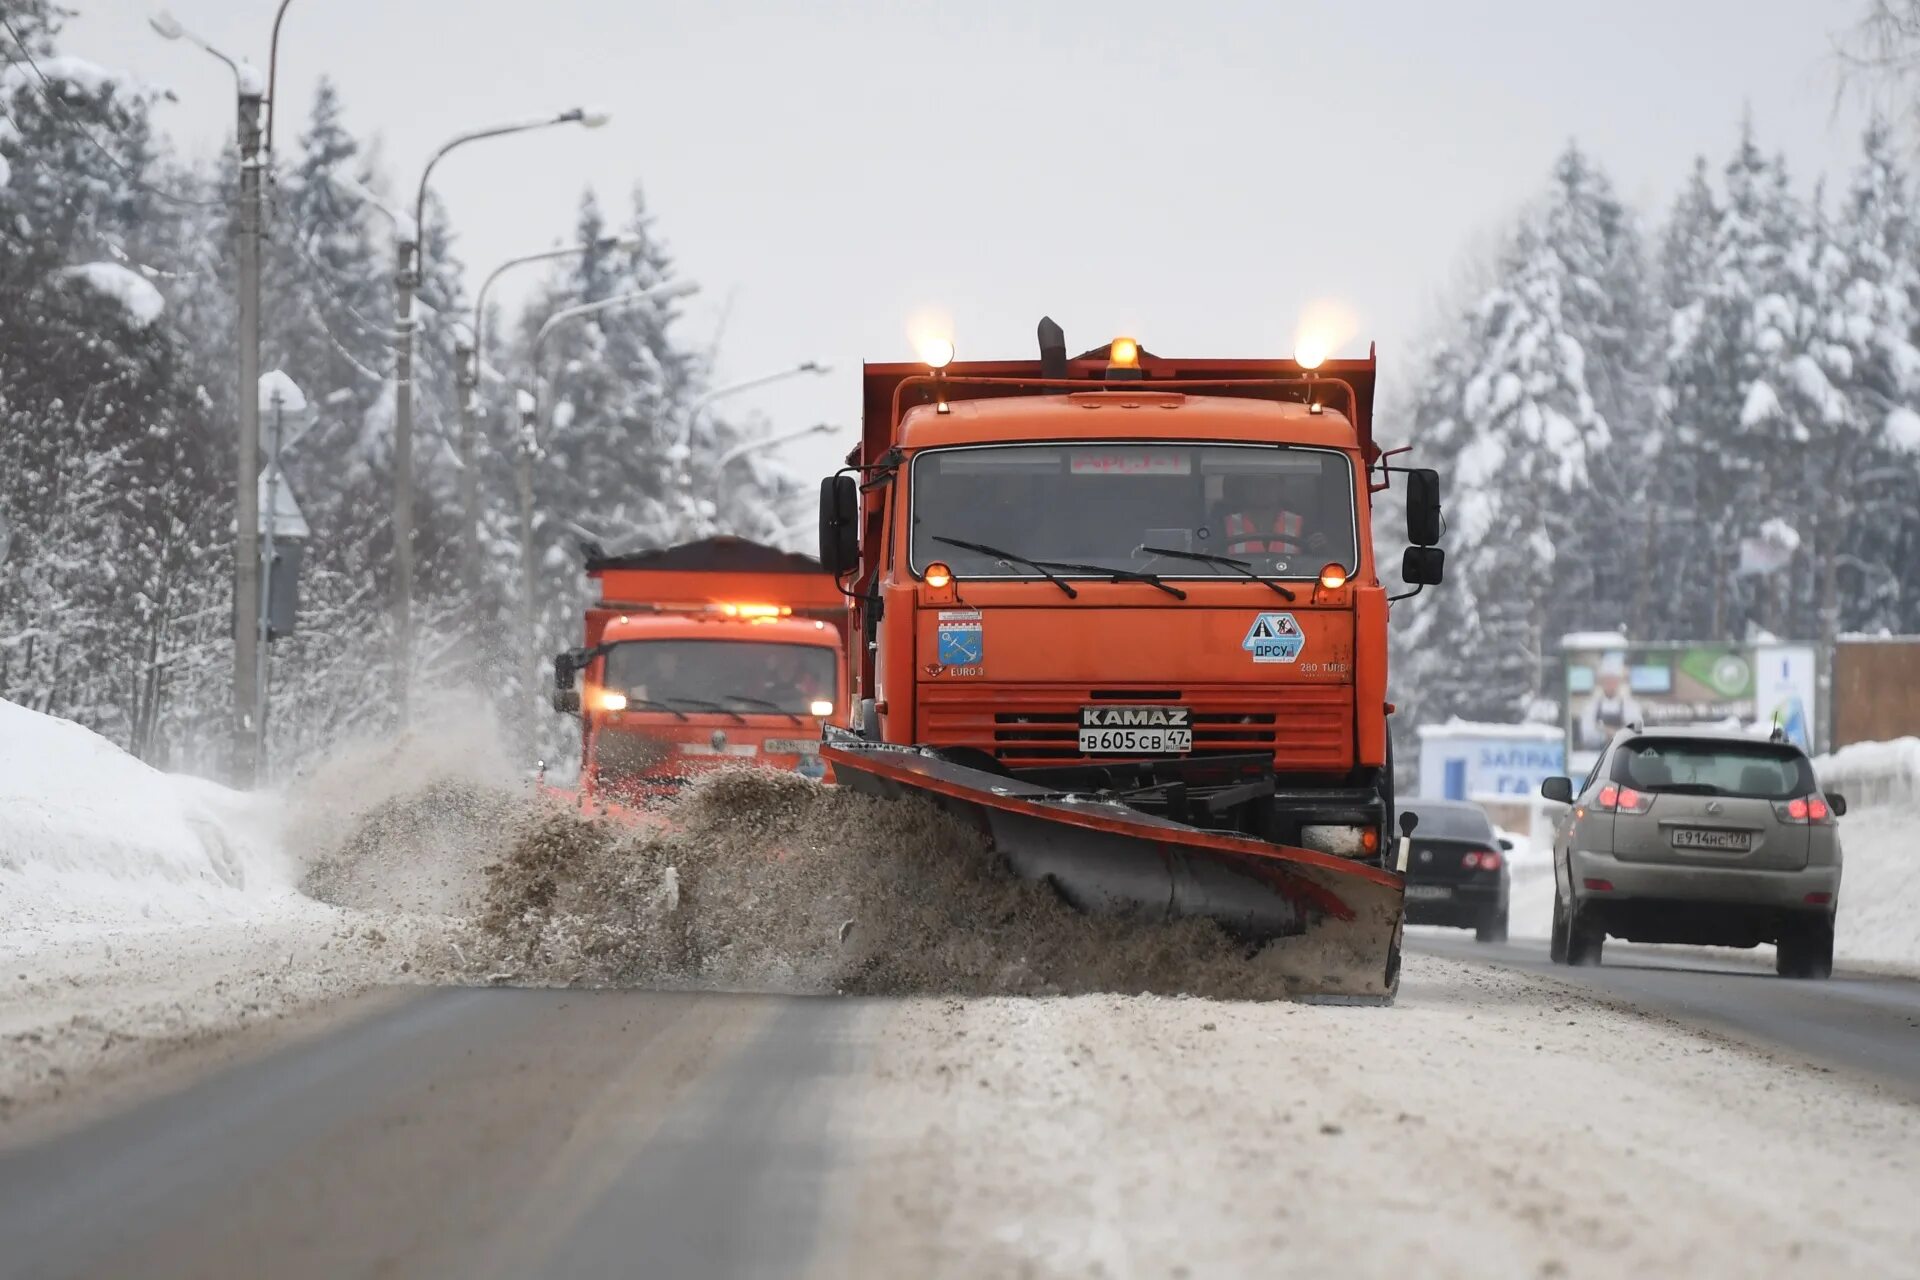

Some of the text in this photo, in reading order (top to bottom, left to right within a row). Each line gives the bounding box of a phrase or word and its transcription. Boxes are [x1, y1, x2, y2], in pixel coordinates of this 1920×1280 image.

[1255, 645, 1288, 657] ДРСУ
[950, 667, 985, 677] EURO 3
[1300, 663, 1318, 672] 280
[1083, 710, 1188, 726] KAMAZ
[1167, 731, 1186, 745] 47
